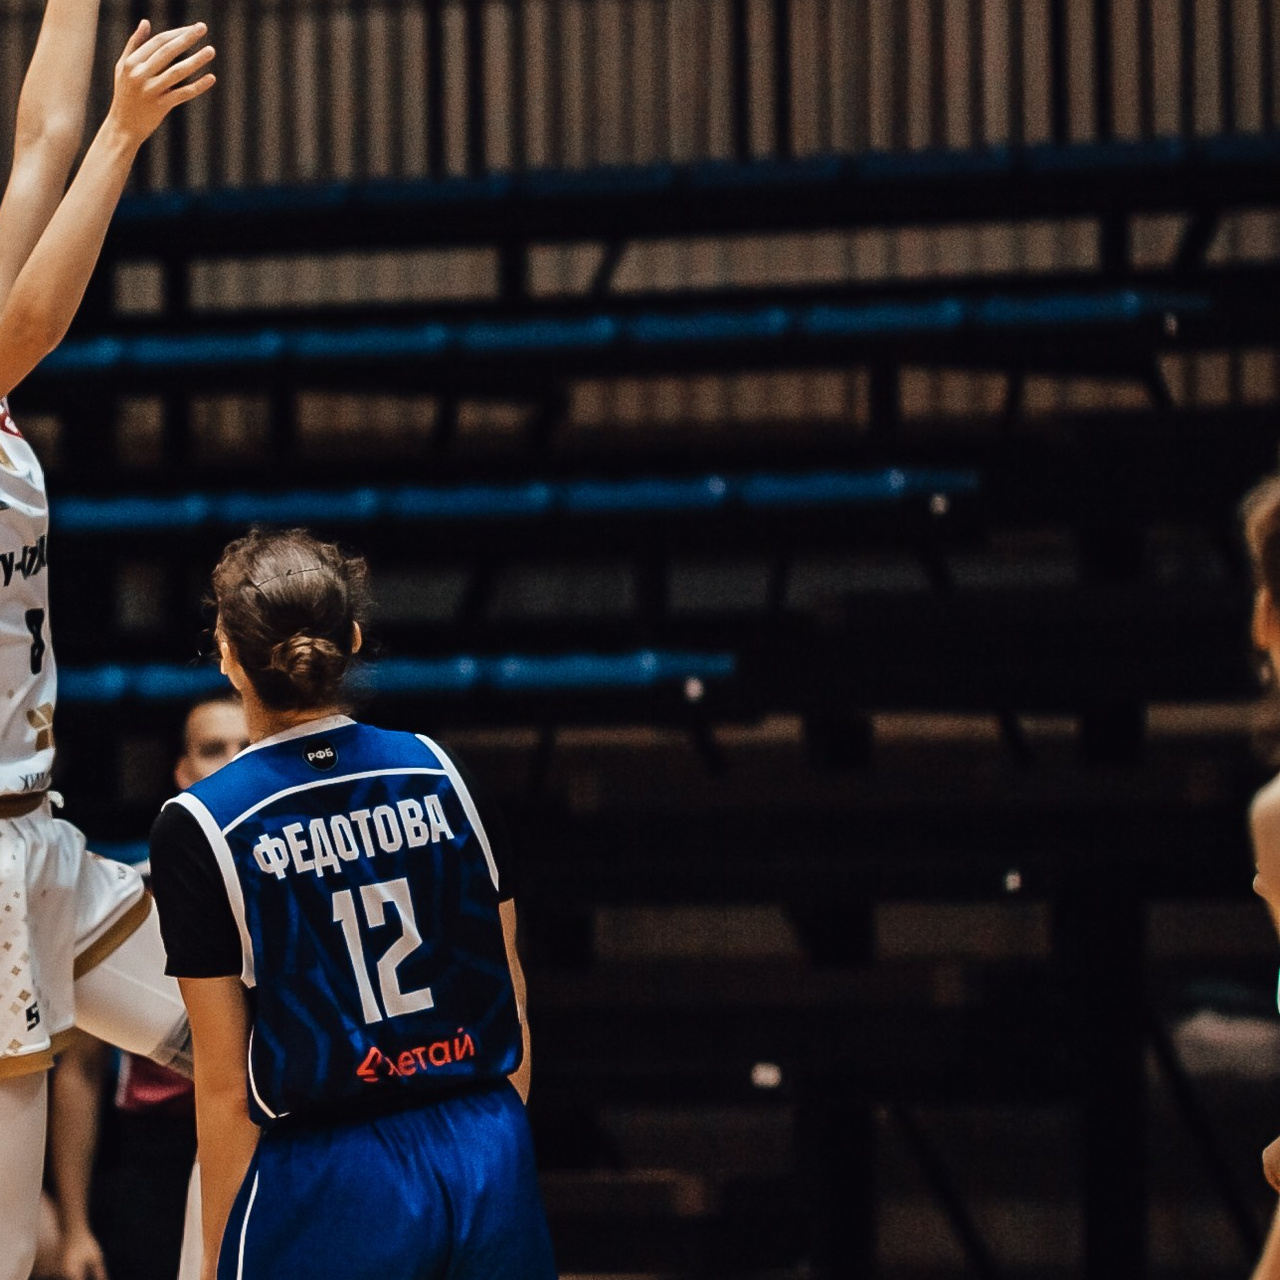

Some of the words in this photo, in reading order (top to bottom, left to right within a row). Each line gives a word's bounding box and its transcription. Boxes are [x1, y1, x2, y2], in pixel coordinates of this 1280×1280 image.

[307, 747, 334, 762] РФБ
[253, 793, 455, 880] ФЕДОТОВА
[332, 876, 435, 1025] 12
